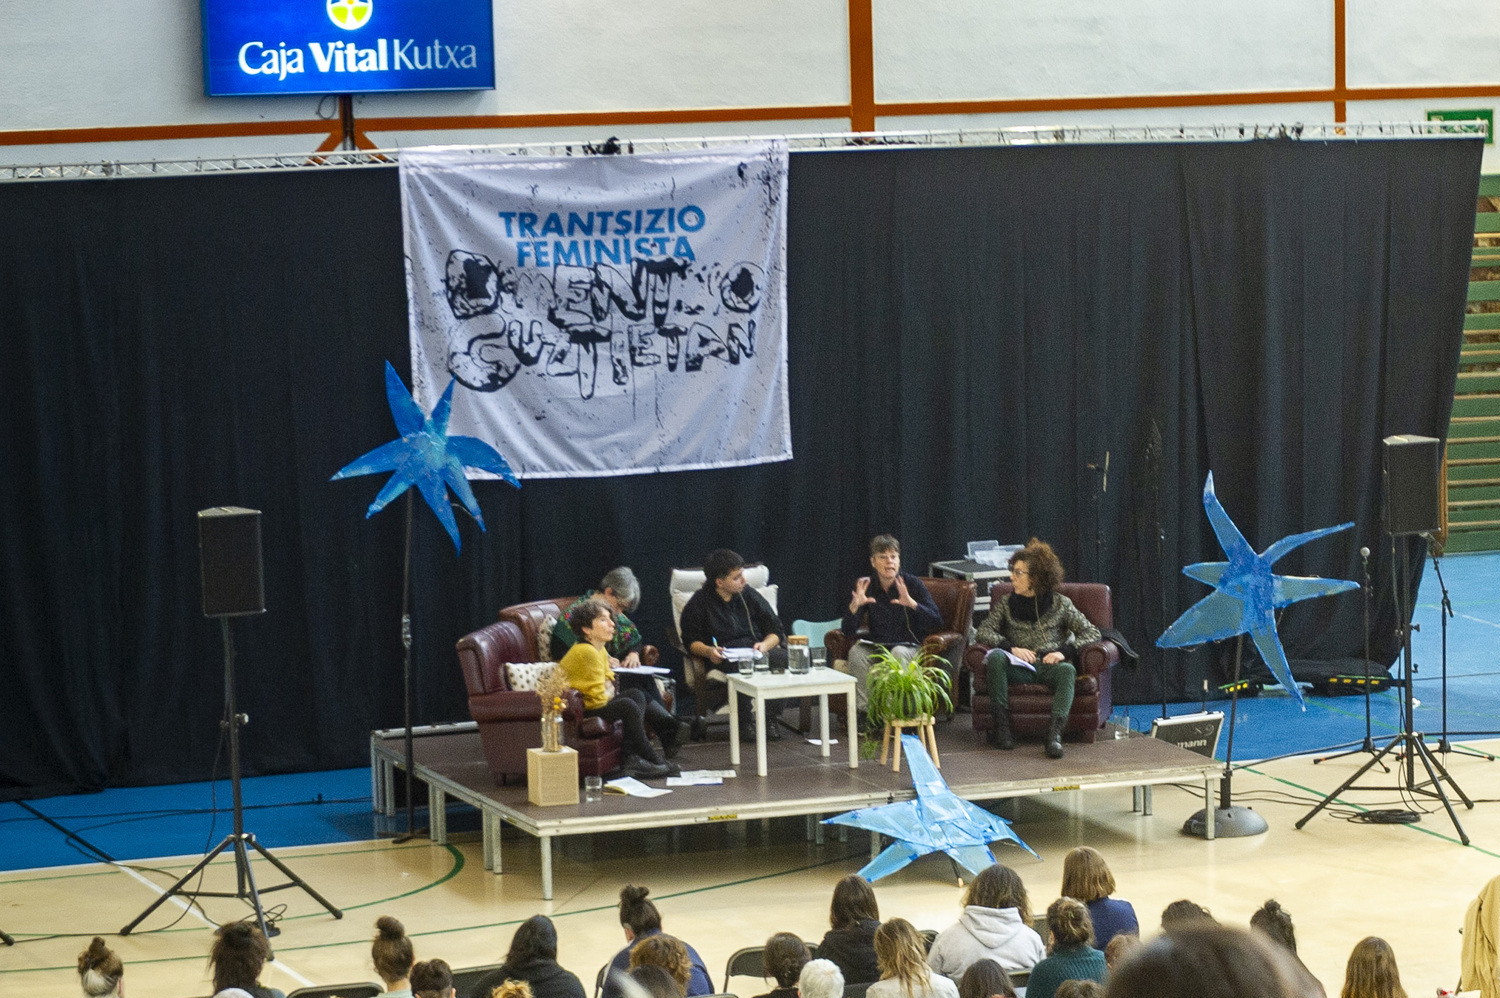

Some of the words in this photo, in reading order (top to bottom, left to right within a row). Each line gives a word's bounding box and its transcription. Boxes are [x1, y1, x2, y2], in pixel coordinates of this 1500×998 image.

[238, 41, 305, 81] Caja
[498, 205, 706, 238] TRANTSIZIO
[516, 236, 697, 268] FEMINISTA
[1176, 738, 1208, 749] mann
